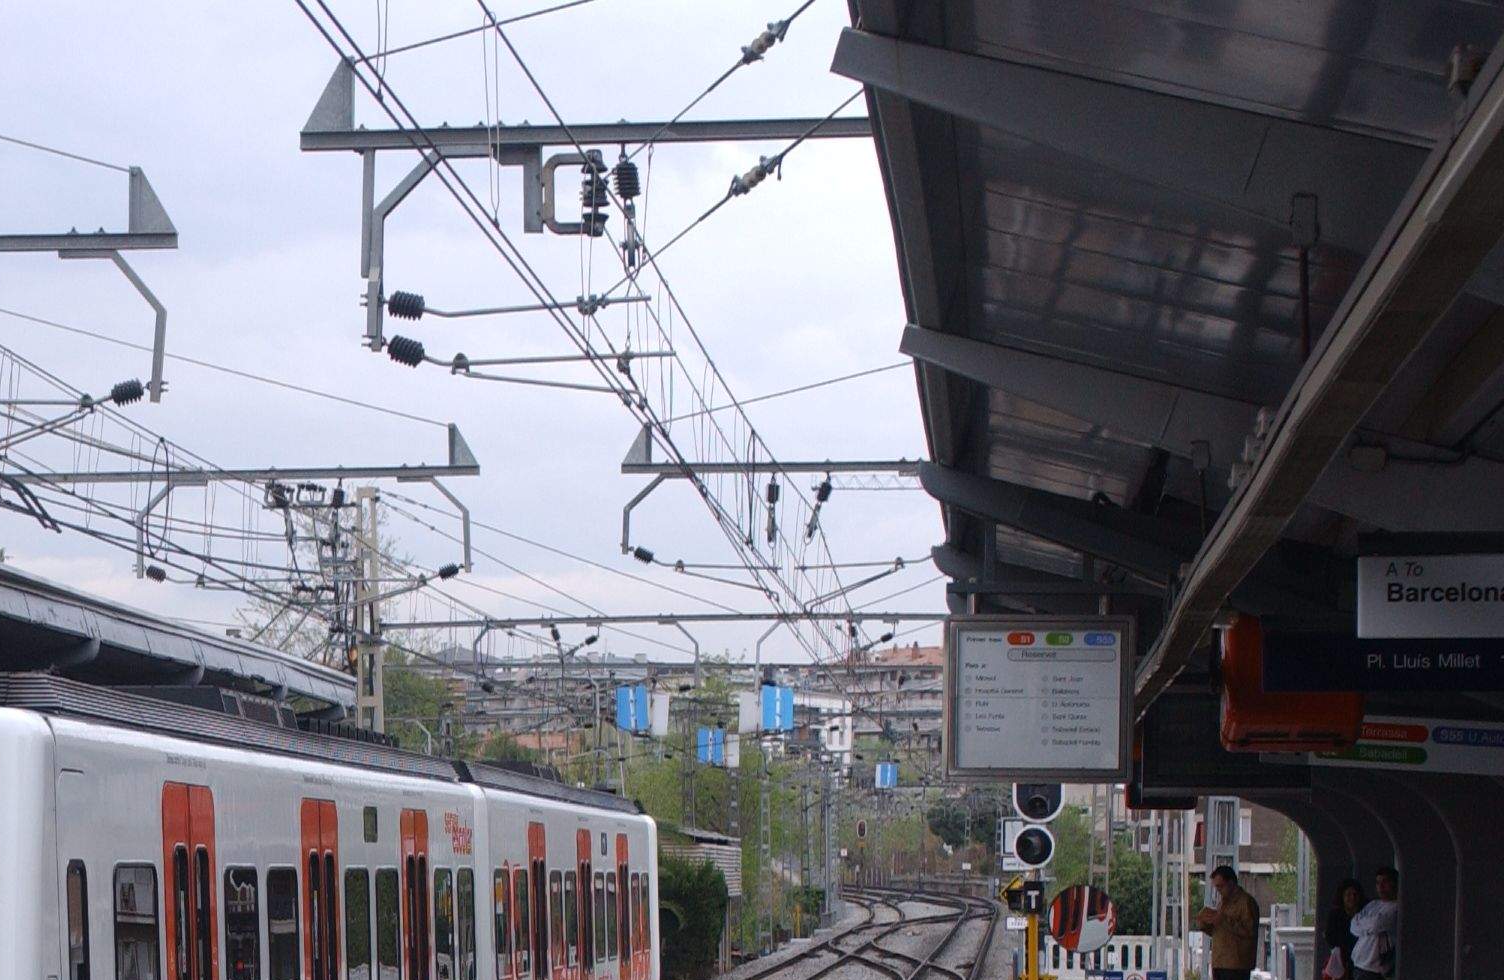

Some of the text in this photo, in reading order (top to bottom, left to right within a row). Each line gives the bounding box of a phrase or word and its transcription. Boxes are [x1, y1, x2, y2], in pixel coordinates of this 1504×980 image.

[1386, 561, 1424, 576] A To
[1367, 652, 1481, 669] Pl. Lluís Millet
